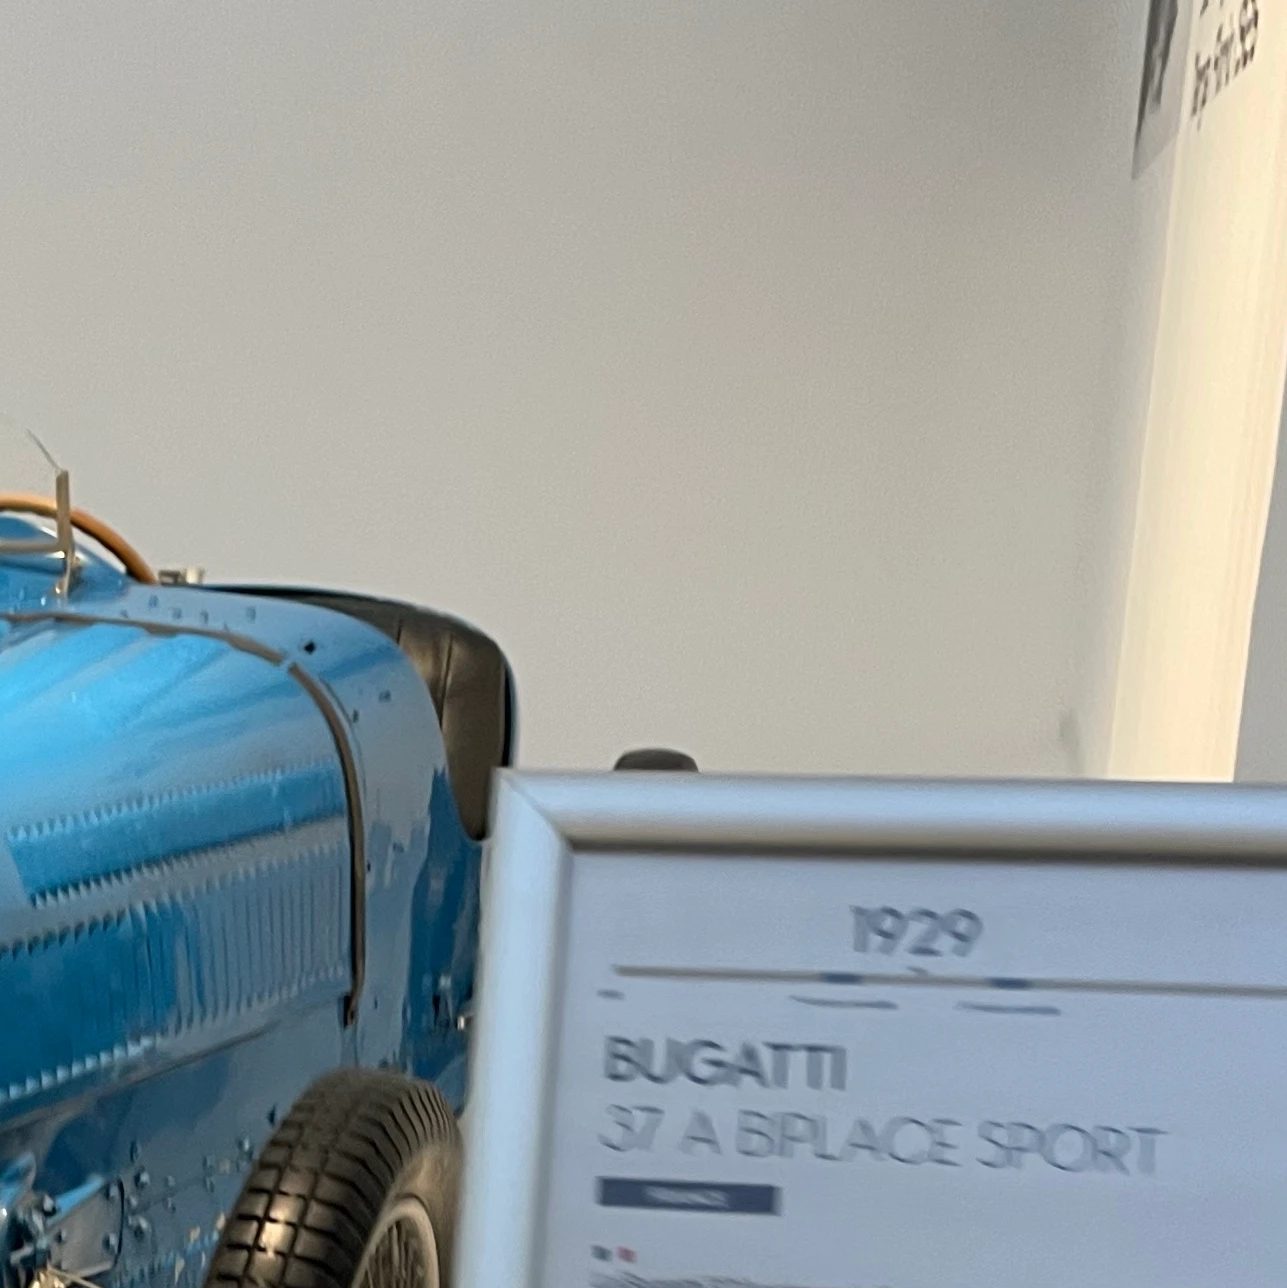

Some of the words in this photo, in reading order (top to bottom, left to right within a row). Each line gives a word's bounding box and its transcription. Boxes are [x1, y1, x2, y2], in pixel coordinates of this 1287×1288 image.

[849, 904, 984, 958] 1929
[602, 1035, 848, 1092] BUGATTI
[678, 1108, 724, 1157] A
[976, 1118, 1169, 1176] SPORT
